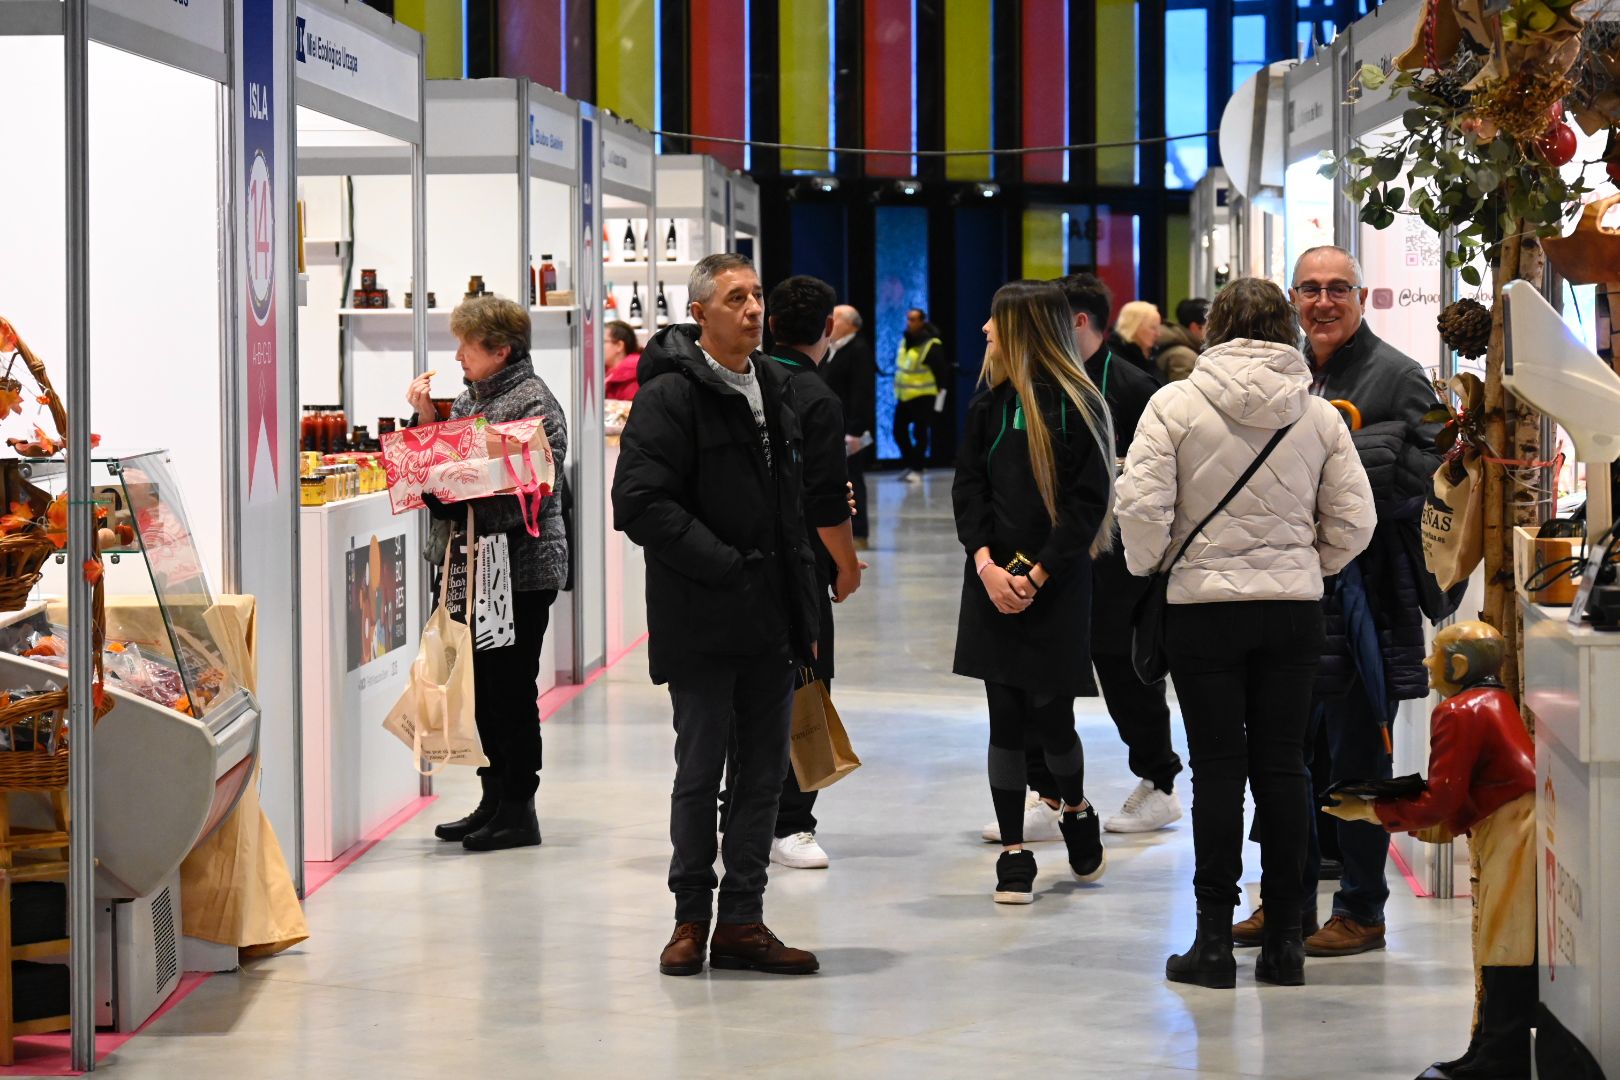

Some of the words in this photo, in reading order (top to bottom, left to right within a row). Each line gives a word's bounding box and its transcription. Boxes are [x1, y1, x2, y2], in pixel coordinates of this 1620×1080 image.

[306, 32, 317, 58] Miel
[249, 82, 269, 121] ISLA
[250, 180, 270, 280] 14
